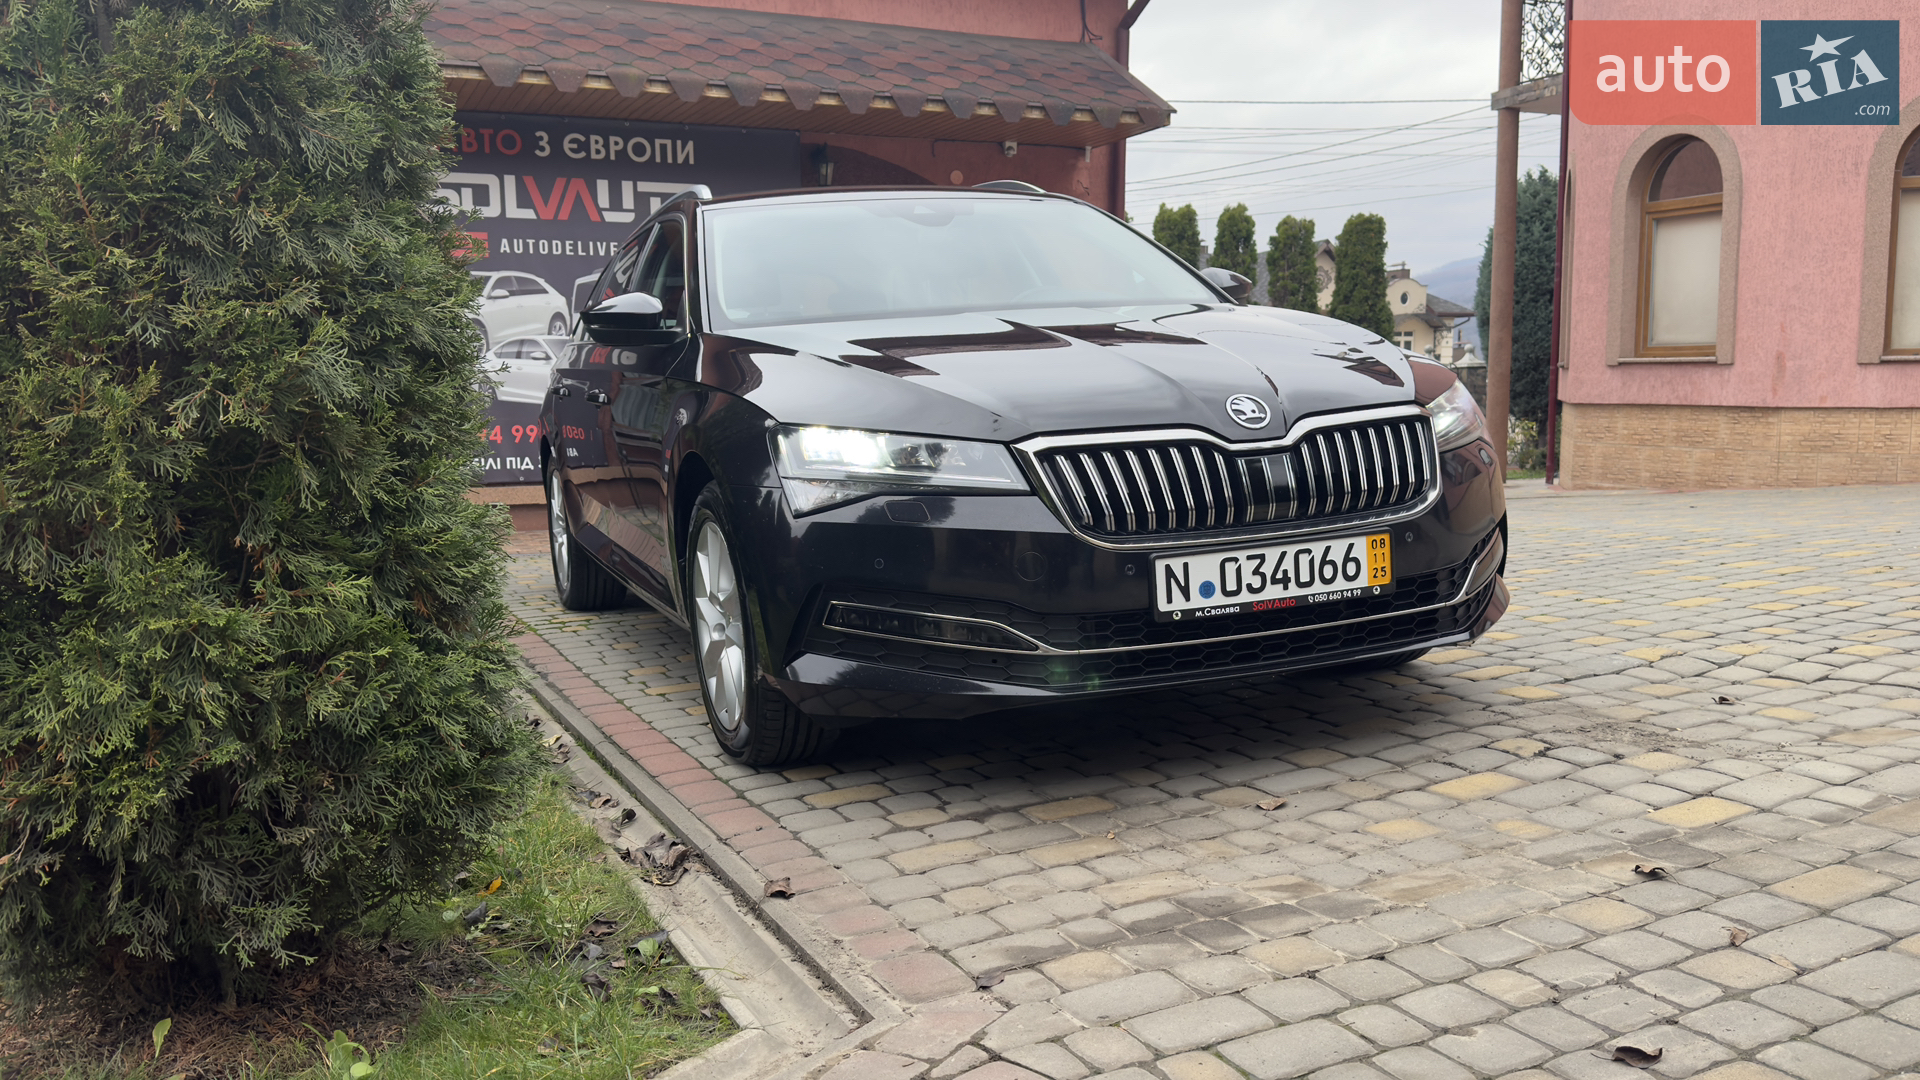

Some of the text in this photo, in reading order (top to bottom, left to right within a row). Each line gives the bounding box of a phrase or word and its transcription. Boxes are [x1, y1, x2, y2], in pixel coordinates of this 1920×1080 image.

[563, 133, 695, 165] ЄВРОПИ
[511, 425, 539, 443] 99
[505, 456, 534, 470] ПІД
[1371, 537, 1386, 550] 08
[1373, 551, 1386, 563] 11
[1164, 542, 1362, 604] N 034066
[1372, 565, 1387, 579] 25
[1314, 588, 1361, 602] 050 660 94 99
[1252, 598, 1297, 611] SolVAuto
